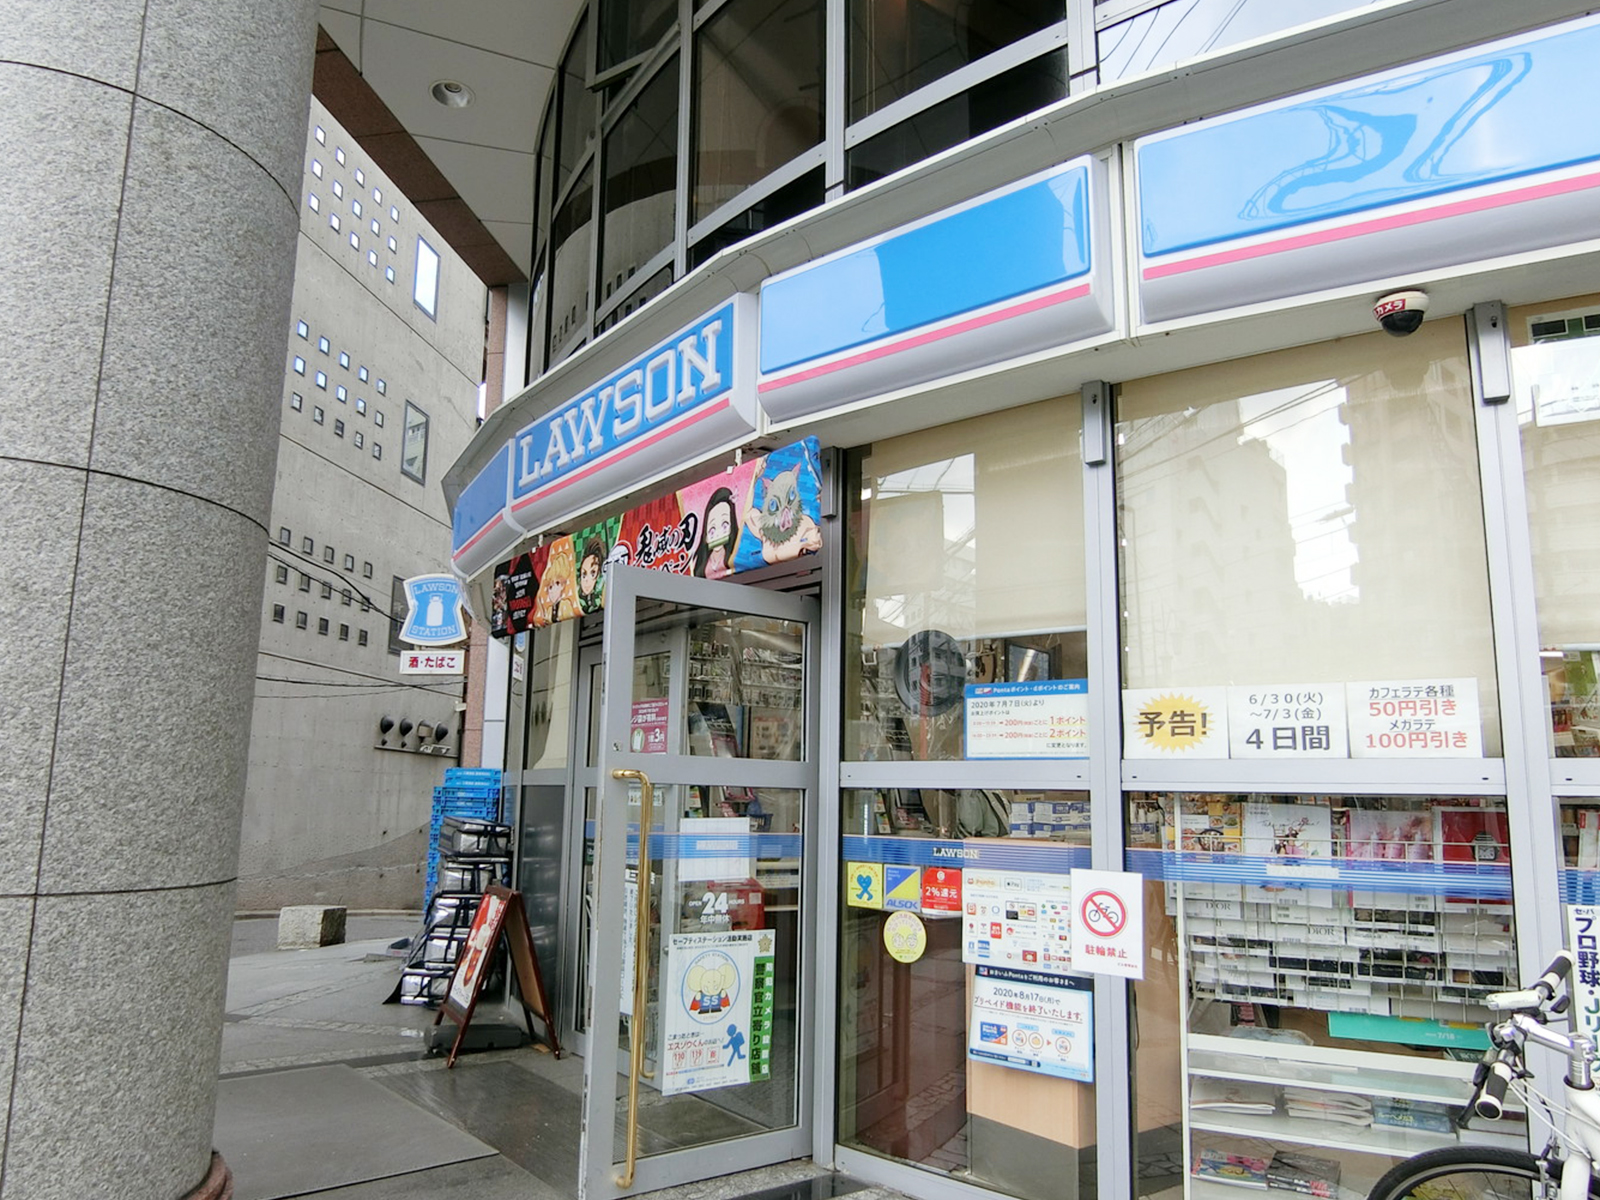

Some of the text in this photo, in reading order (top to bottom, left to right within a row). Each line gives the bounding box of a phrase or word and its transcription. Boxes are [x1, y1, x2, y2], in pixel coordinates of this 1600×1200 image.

[1374, 300, 1404, 318] カメラ
[518, 318, 723, 489] LAWSON
[636, 512, 698, 563] 鬼滅の刃
[413, 582, 459, 595] LAWSON
[411, 625, 456, 637] STATION
[408, 656, 456, 669] 酒・たばこ
[1248, 691, 1324, 705] 6/30(火)
[1368, 684, 1455, 700] カフェラテ各種
[971, 699, 1045, 709] 2020年7月7日(火)より
[1368, 699, 1457, 718] 50円引き
[1137, 710, 1208, 738] 予告!
[1388, 719, 1437, 732] メガラテ
[1049, 728, 1087, 738] 2ポイント
[1244, 725, 1331, 751] 4日間
[1365, 730, 1469, 750] 100円引き
[933, 847, 979, 859] LAWSON
[925, 886, 958, 899] 2%還元
[701, 891, 729, 915] 24
[886, 898, 919, 910] ALSOK
[1205, 902, 1231, 911] DOR
[700, 914, 730, 925] 年中無休
[1307, 926, 1335, 936] DIOR
[1085, 944, 1128, 959] 駐輪禁止
[702, 995, 719, 1007] SS
[974, 996, 1083, 1021] プリペイド機能を終了いたします。
[751, 963, 766, 1075] 警察官立寄り店舗
